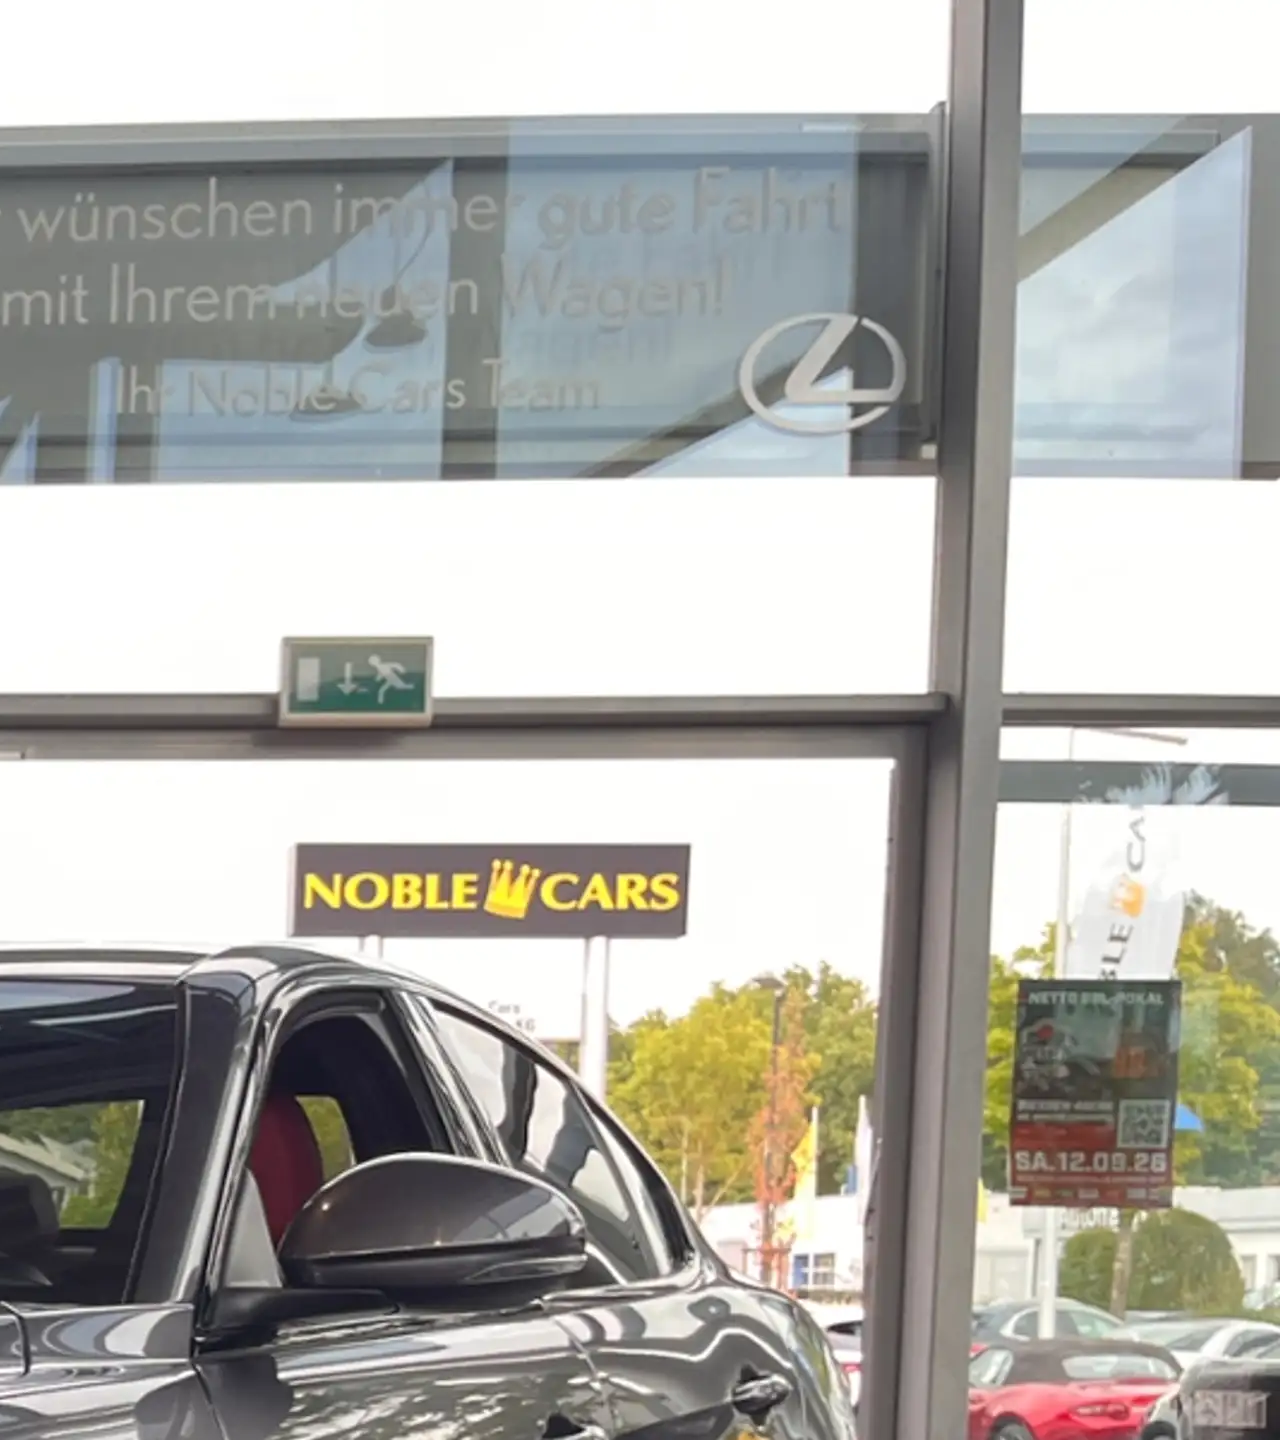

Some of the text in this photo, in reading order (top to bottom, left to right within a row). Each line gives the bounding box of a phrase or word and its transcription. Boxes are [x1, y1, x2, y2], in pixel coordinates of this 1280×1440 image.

[17, 176, 312, 242] wünschen
[537, 181, 676, 250] gute
[2, 254, 726, 328] mit Ihrem neuen Wagen!
[117, 357, 600, 417] Ihr Noble Cars Team
[303, 872, 680, 912] NOBLE CARS
